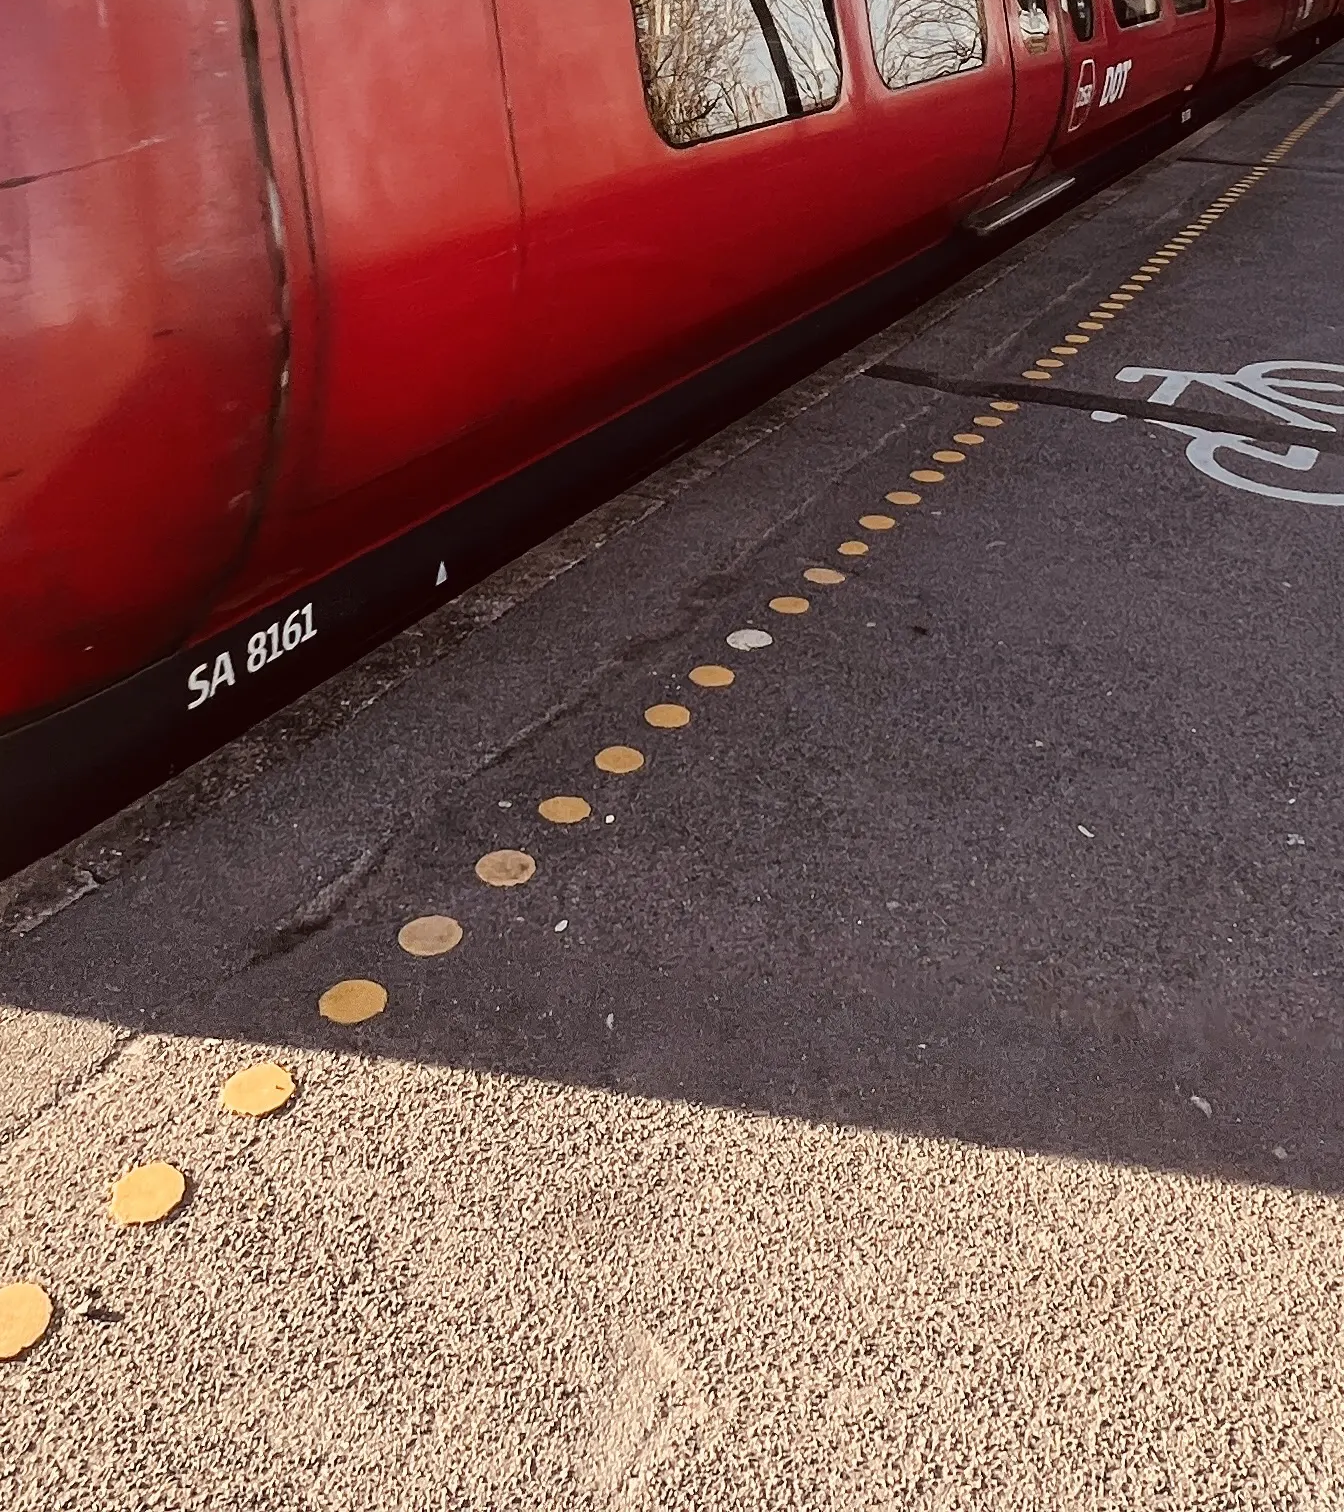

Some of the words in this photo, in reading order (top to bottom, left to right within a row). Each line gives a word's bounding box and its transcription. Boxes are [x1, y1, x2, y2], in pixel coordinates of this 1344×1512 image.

[1099, 58, 1132, 108] DOT
[187, 650, 236, 711] SA
[246, 602, 318, 674] 8161
